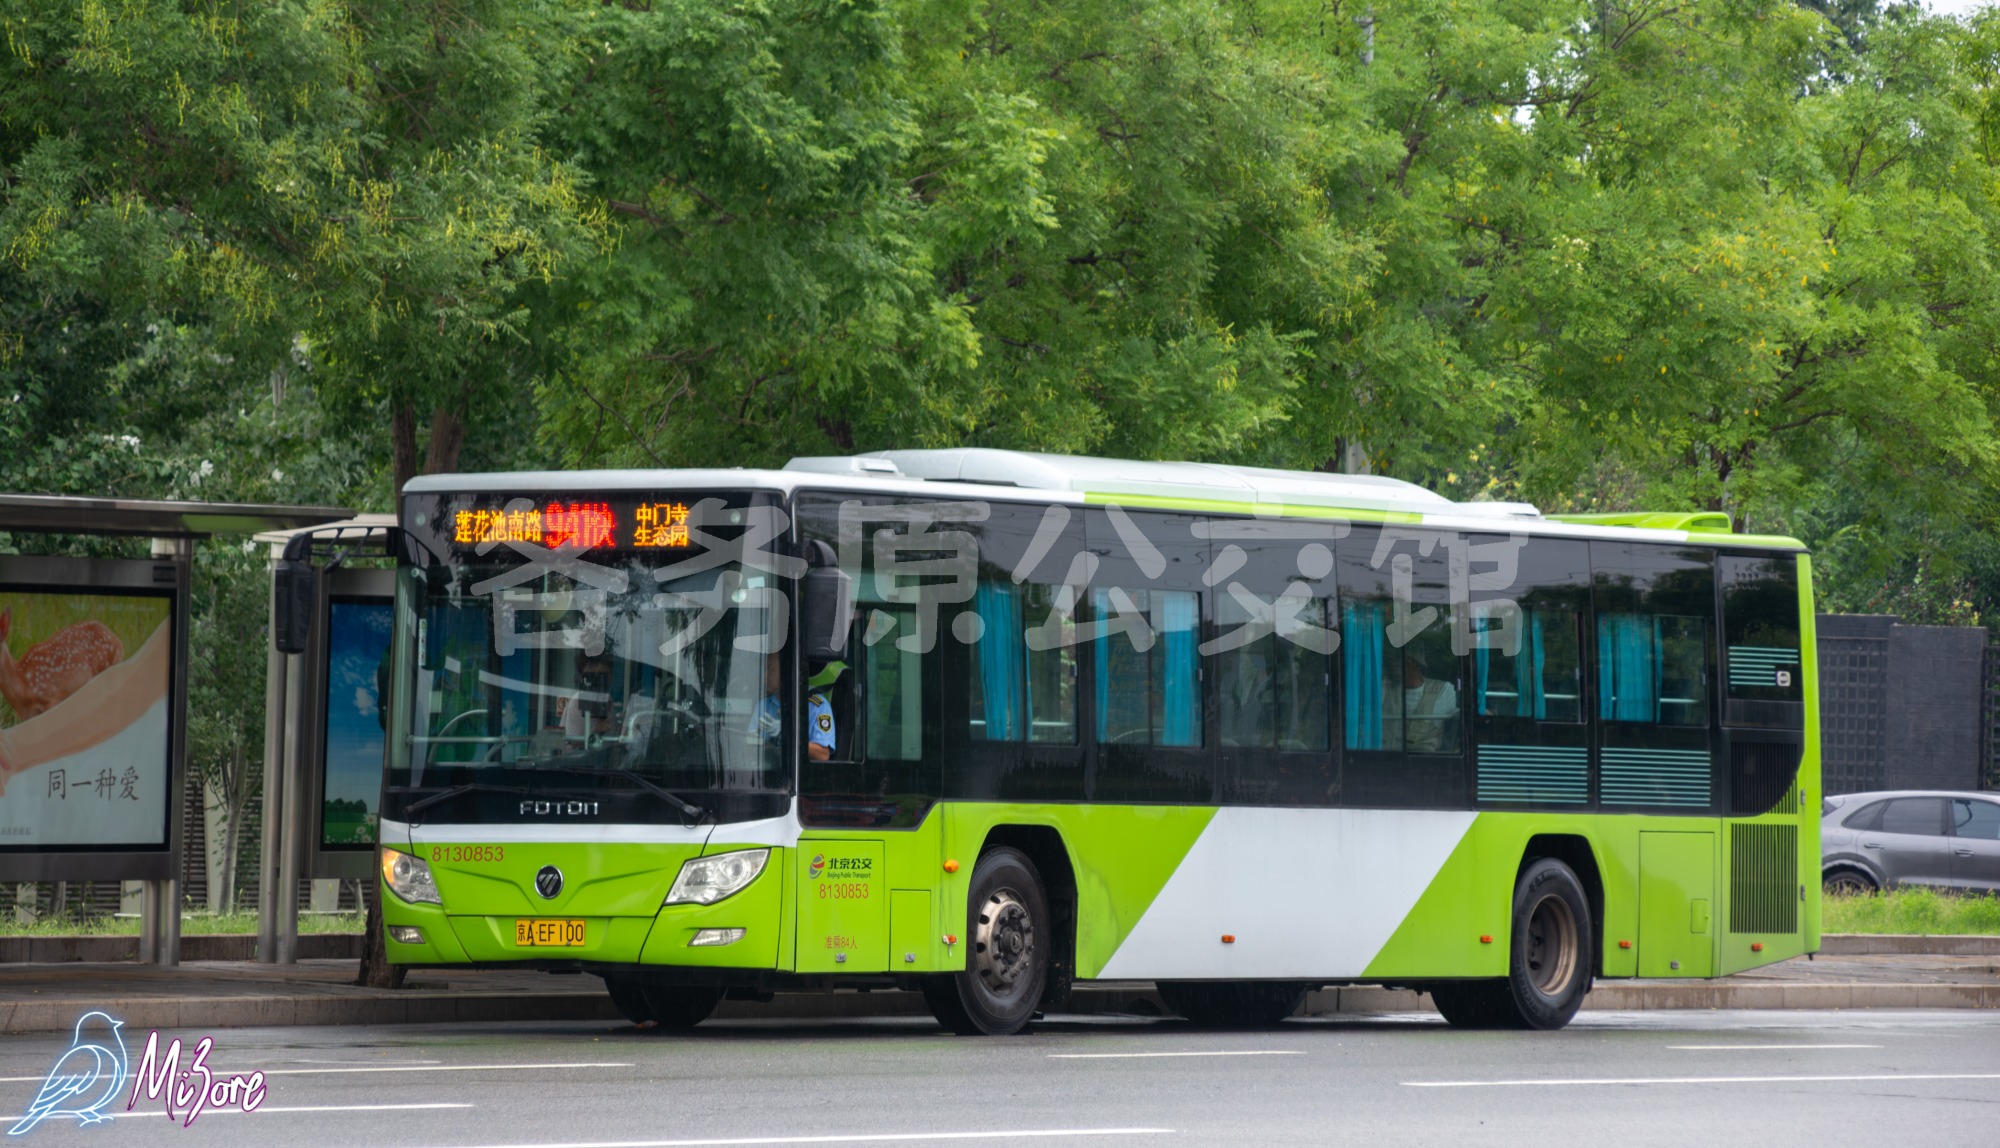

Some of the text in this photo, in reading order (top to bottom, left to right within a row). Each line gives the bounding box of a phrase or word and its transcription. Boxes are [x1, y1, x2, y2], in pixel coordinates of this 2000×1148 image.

[636, 503, 689, 526] 中门寺
[455, 503, 616, 547] 莲花池南路 941快
[634, 526, 689, 547] 生态园
[48, 766, 139, 800] 同一种爱
[520, 801, 598, 815] FOTON
[432, 846, 504, 862] 8130853
[828, 858, 872, 869] 北京公交
[820, 883, 869, 899] 8130853
[825, 935, 858, 949] 准乘84人
